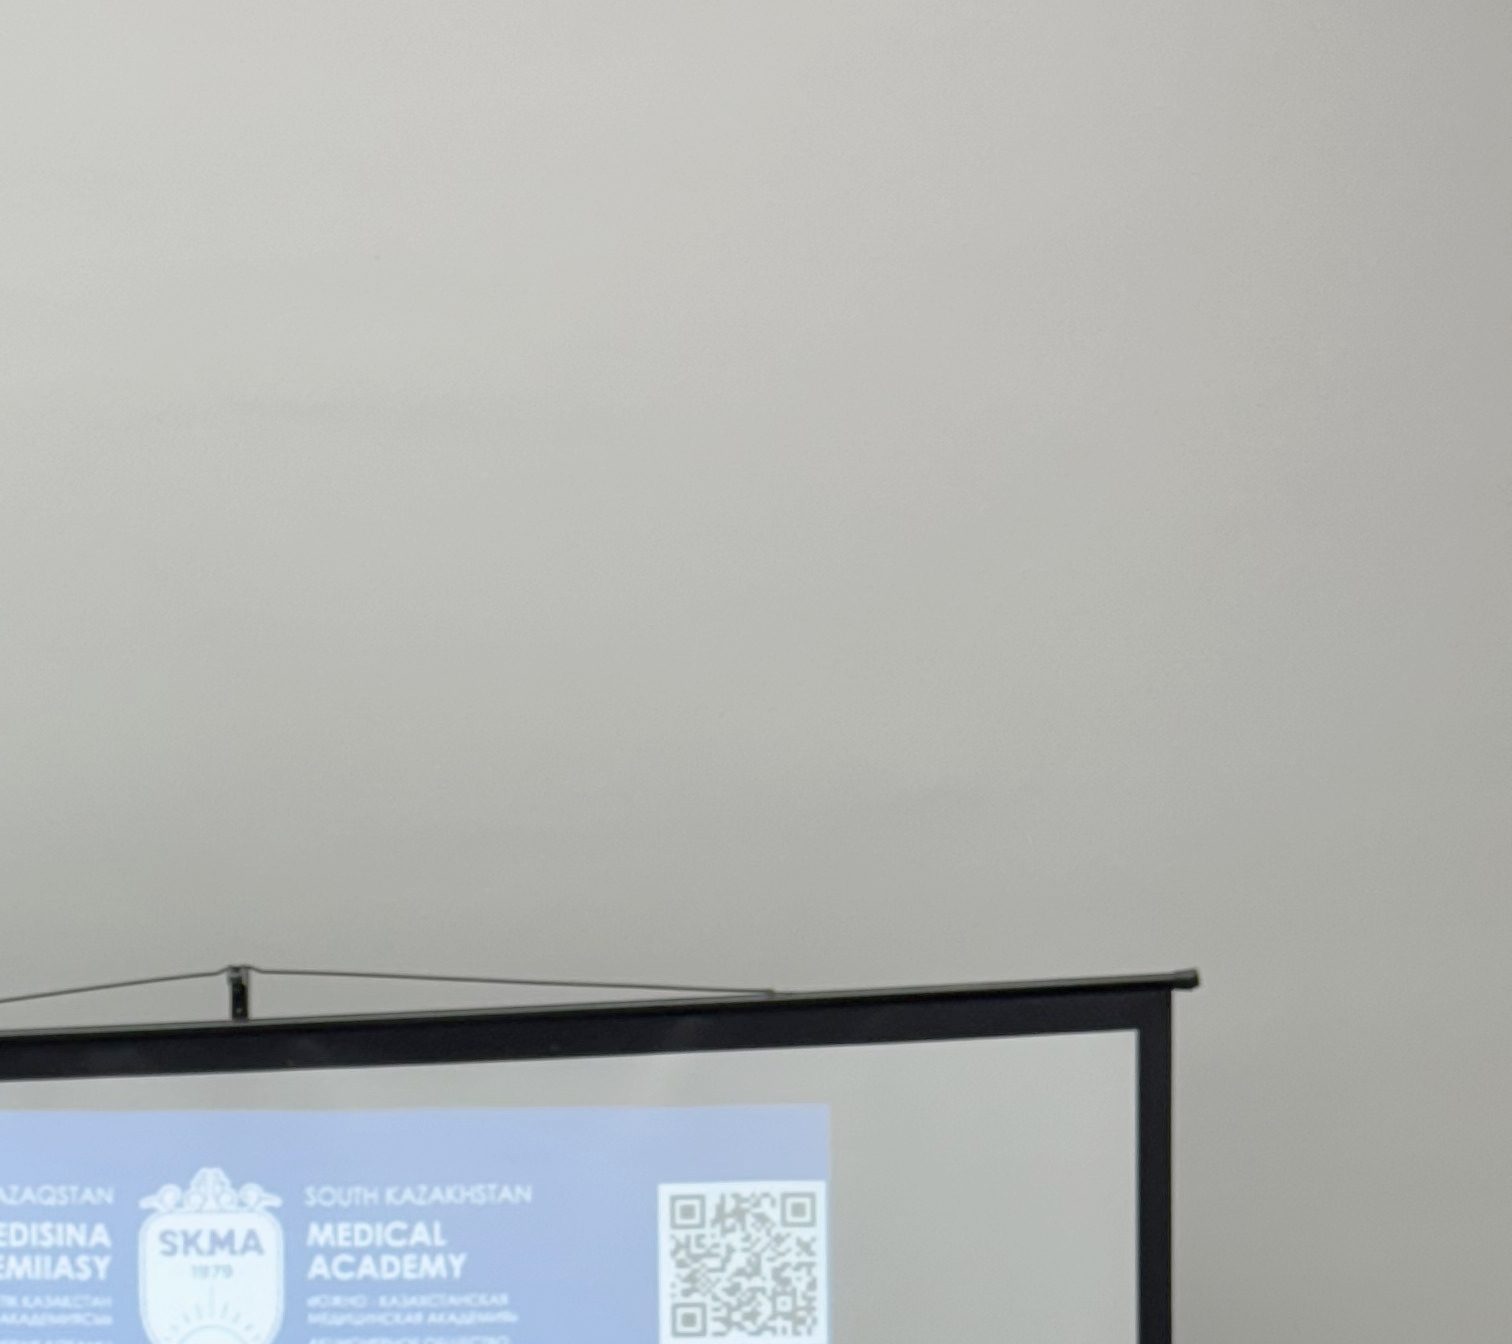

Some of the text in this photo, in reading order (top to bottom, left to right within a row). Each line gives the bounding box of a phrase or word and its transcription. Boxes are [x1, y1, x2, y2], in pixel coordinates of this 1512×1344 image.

[305, 1183, 533, 1207] SOUTH KAZAKHSTAN
[158, 1228, 265, 1256] SKMA
[307, 1220, 446, 1248] MEDICAL
[307, 1252, 467, 1280] ACADEMY
